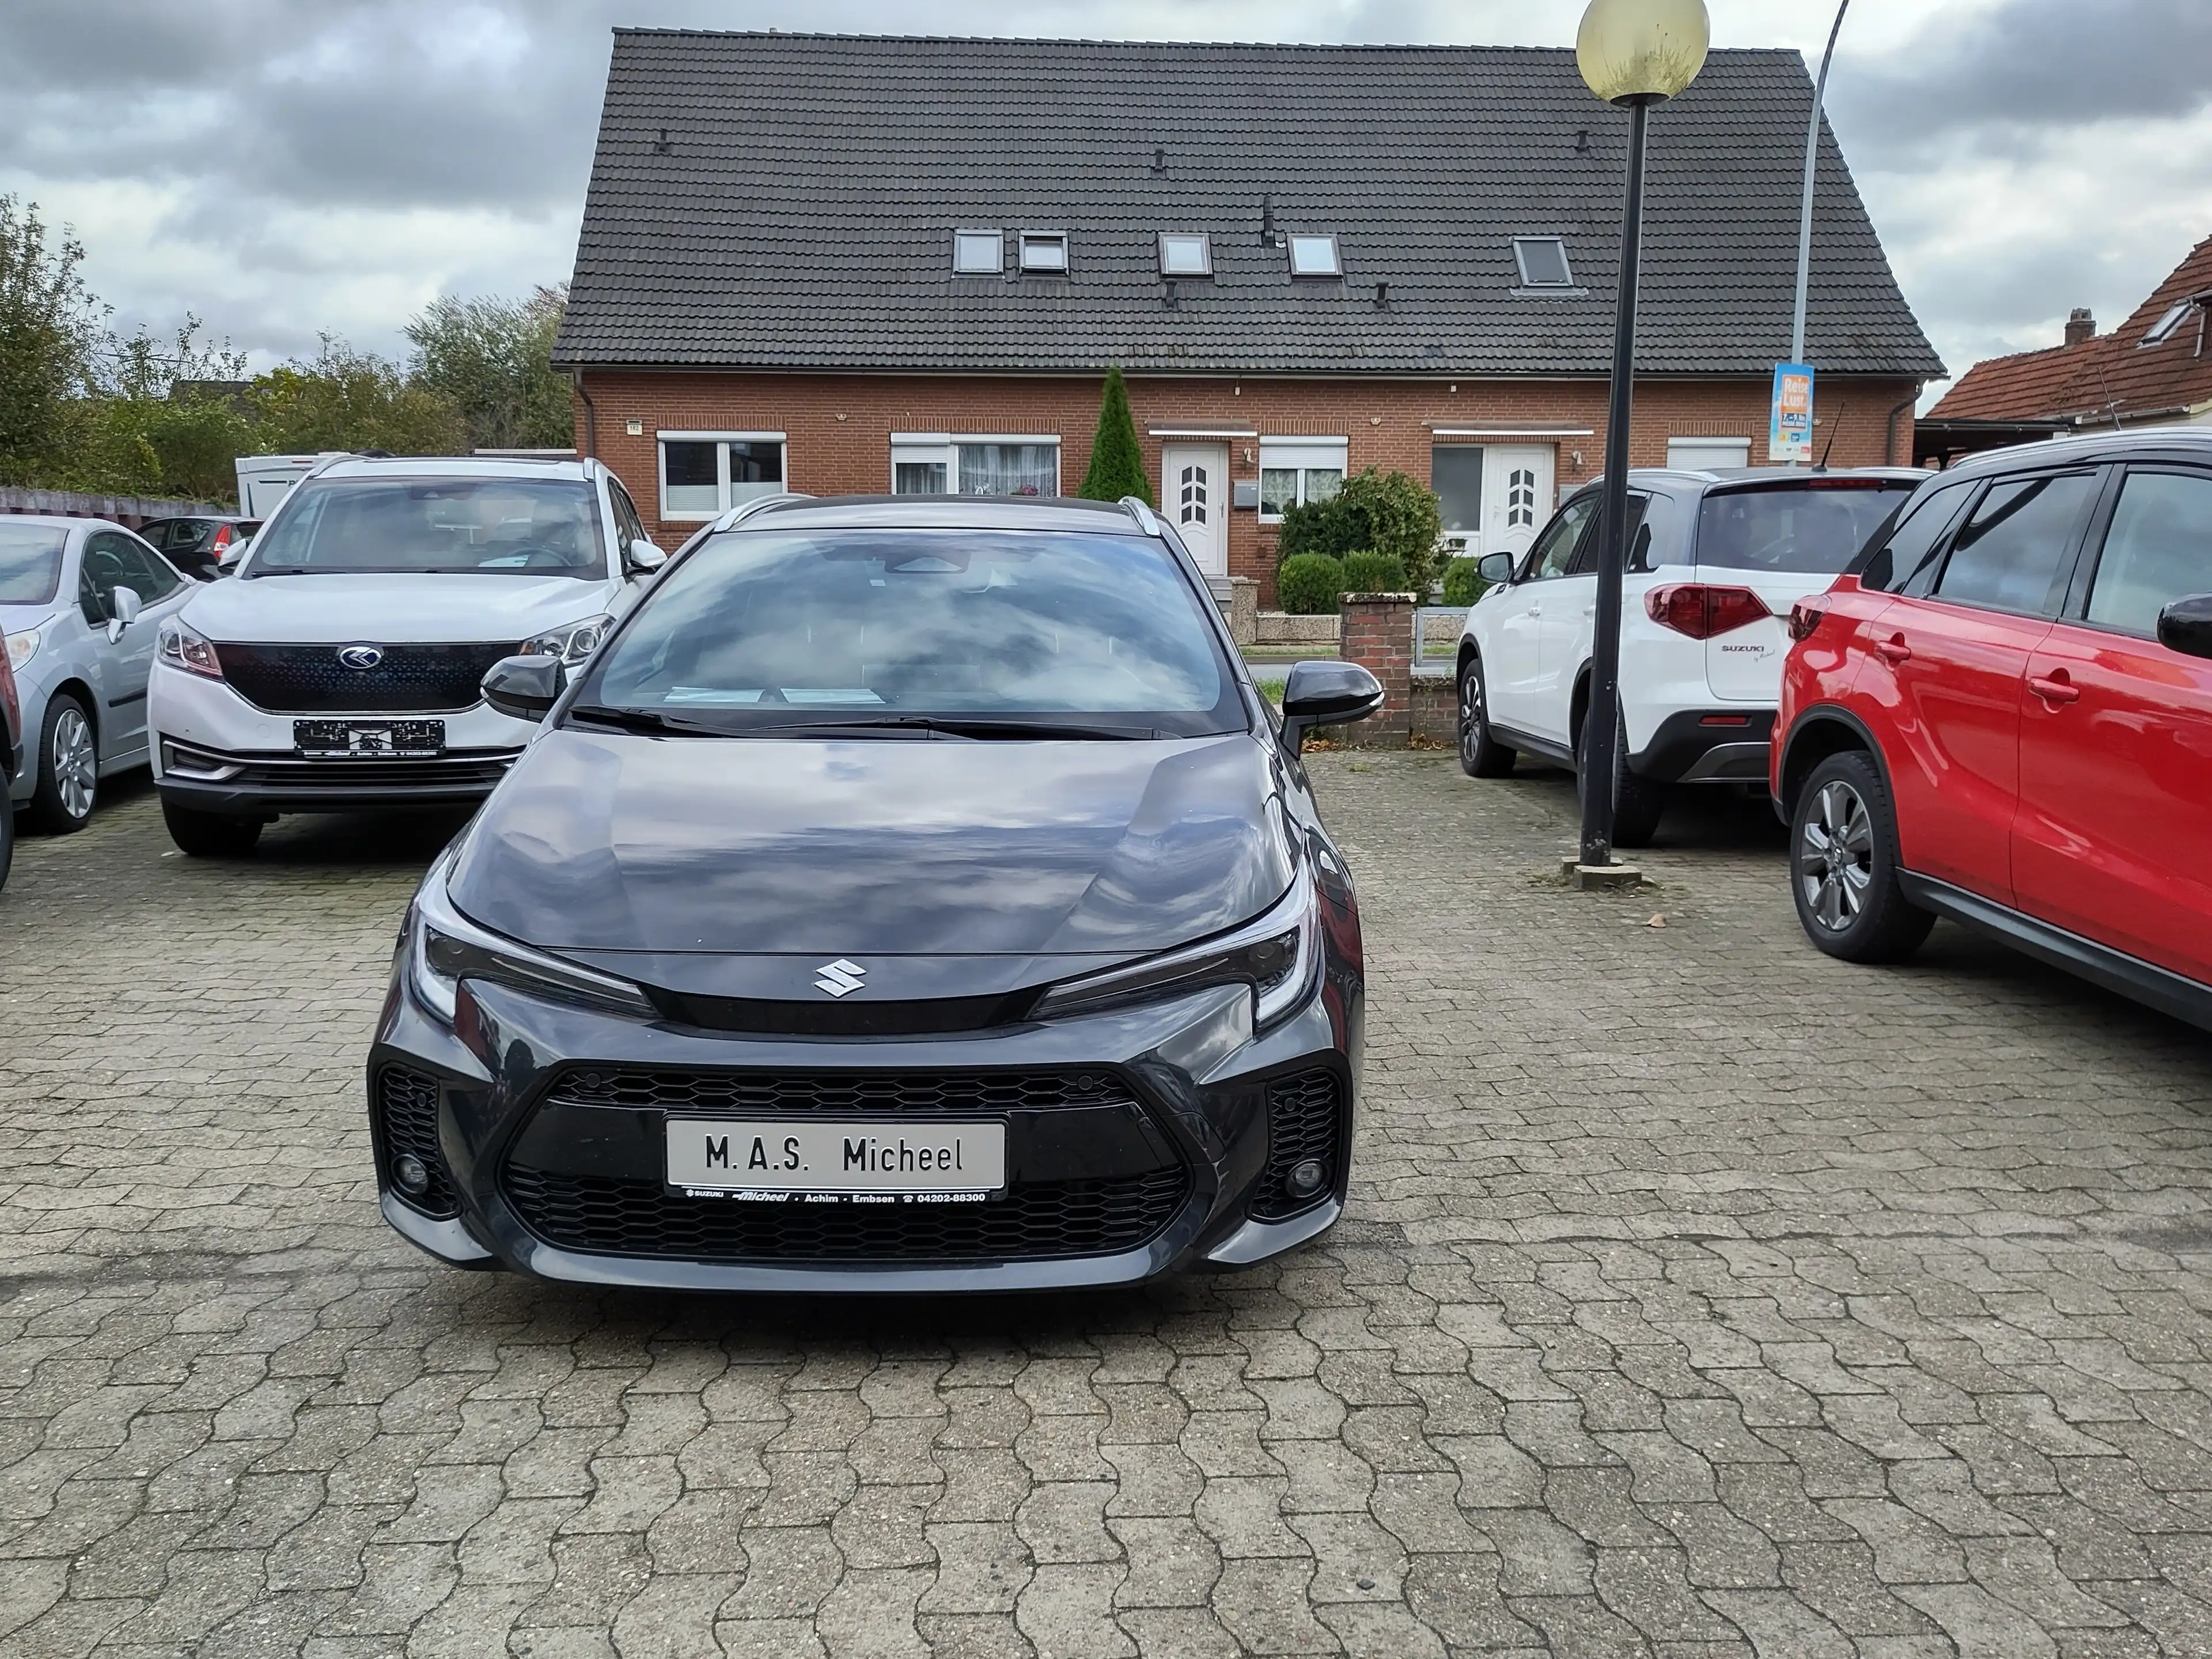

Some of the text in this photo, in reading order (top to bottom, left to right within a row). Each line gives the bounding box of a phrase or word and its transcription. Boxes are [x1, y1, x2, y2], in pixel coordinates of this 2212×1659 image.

[843, 1137, 963, 1171] Micheel
[733, 1191, 790, 1202] Micheel
[805, 1194, 839, 1203] Achim
[853, 1195, 895, 1203] Embsen
[917, 1194, 986, 1203] 04202-88300
